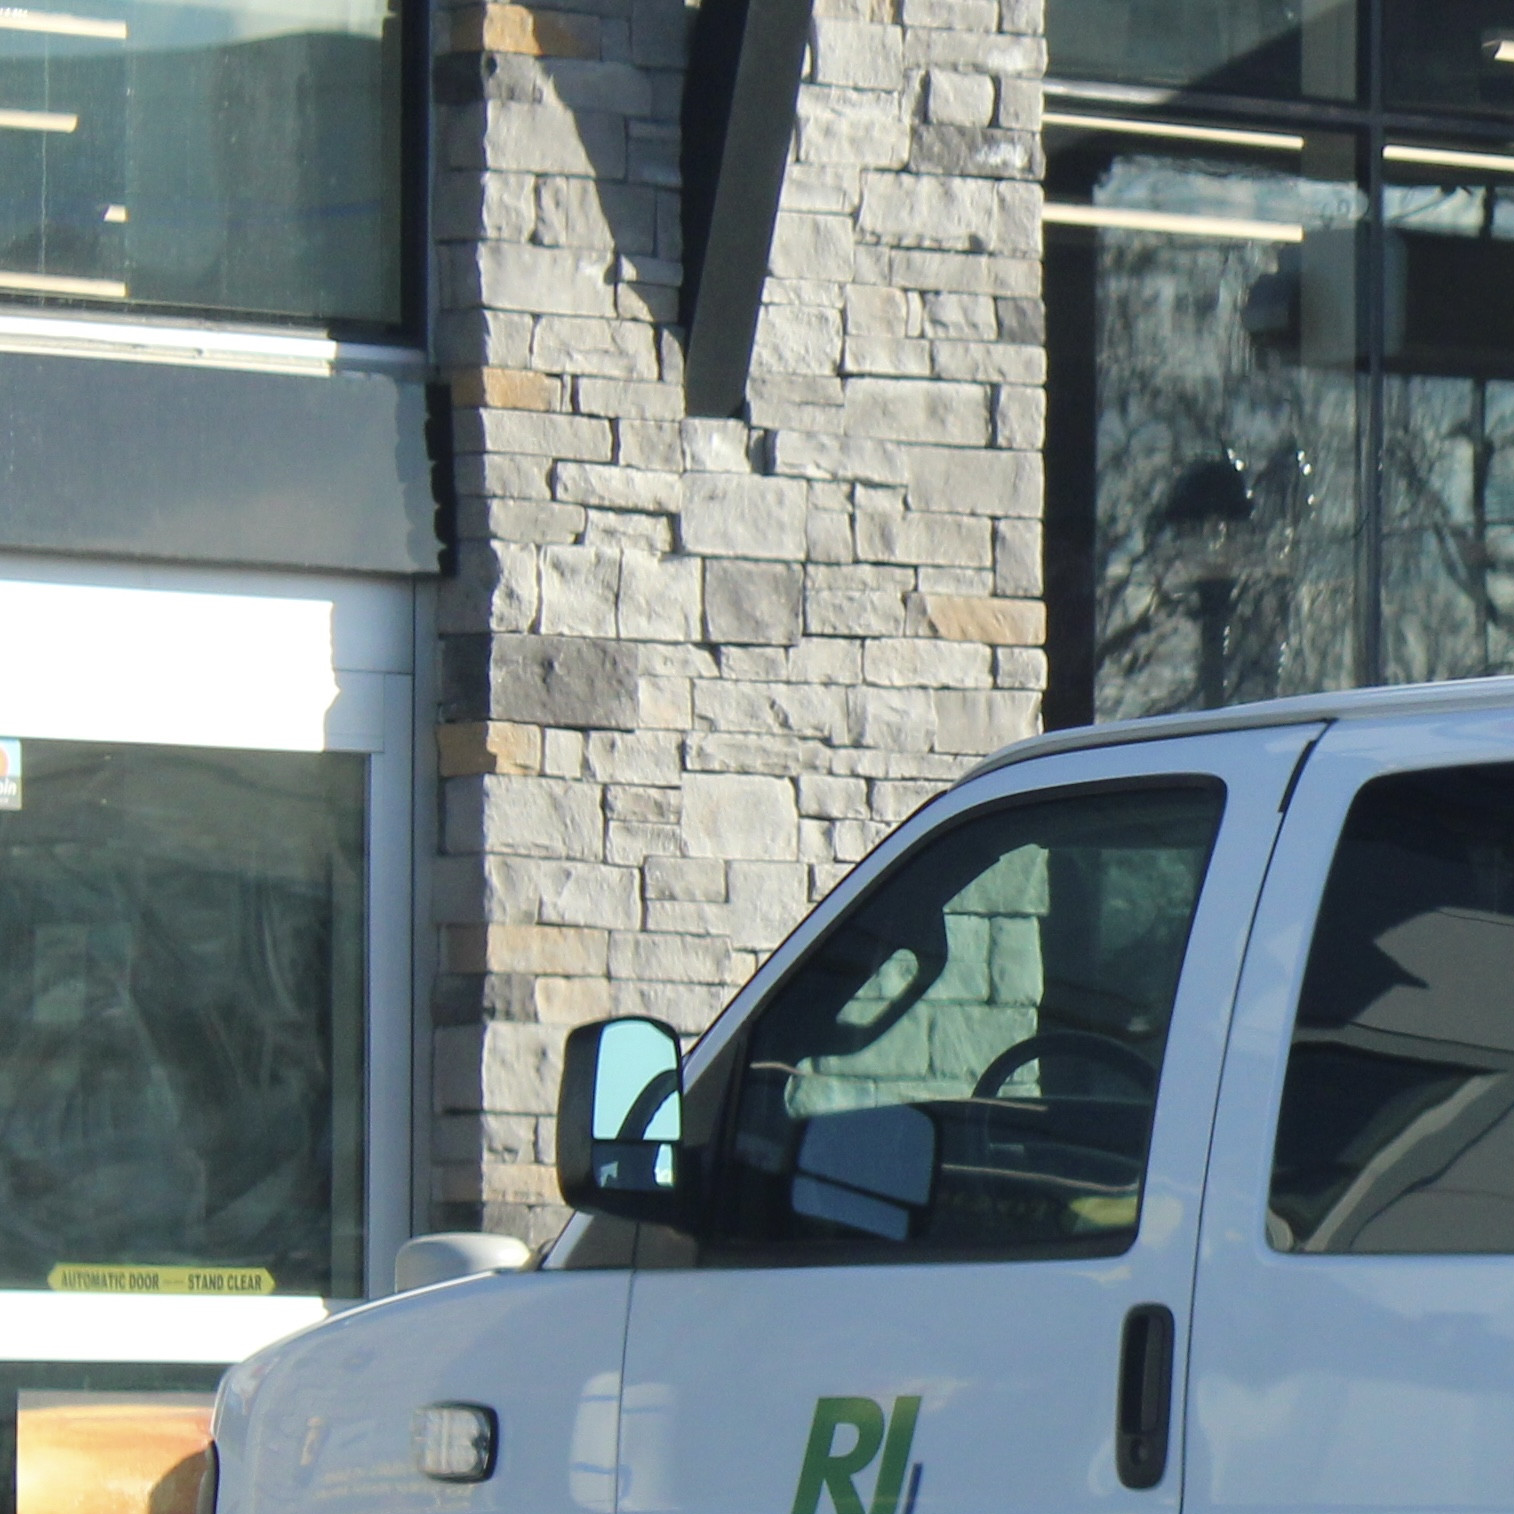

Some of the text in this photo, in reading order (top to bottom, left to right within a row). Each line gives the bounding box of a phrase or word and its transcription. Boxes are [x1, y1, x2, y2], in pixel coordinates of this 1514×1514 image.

[60, 1270, 262, 1292] AUTOMATIC DOOR STAND CLEAR
